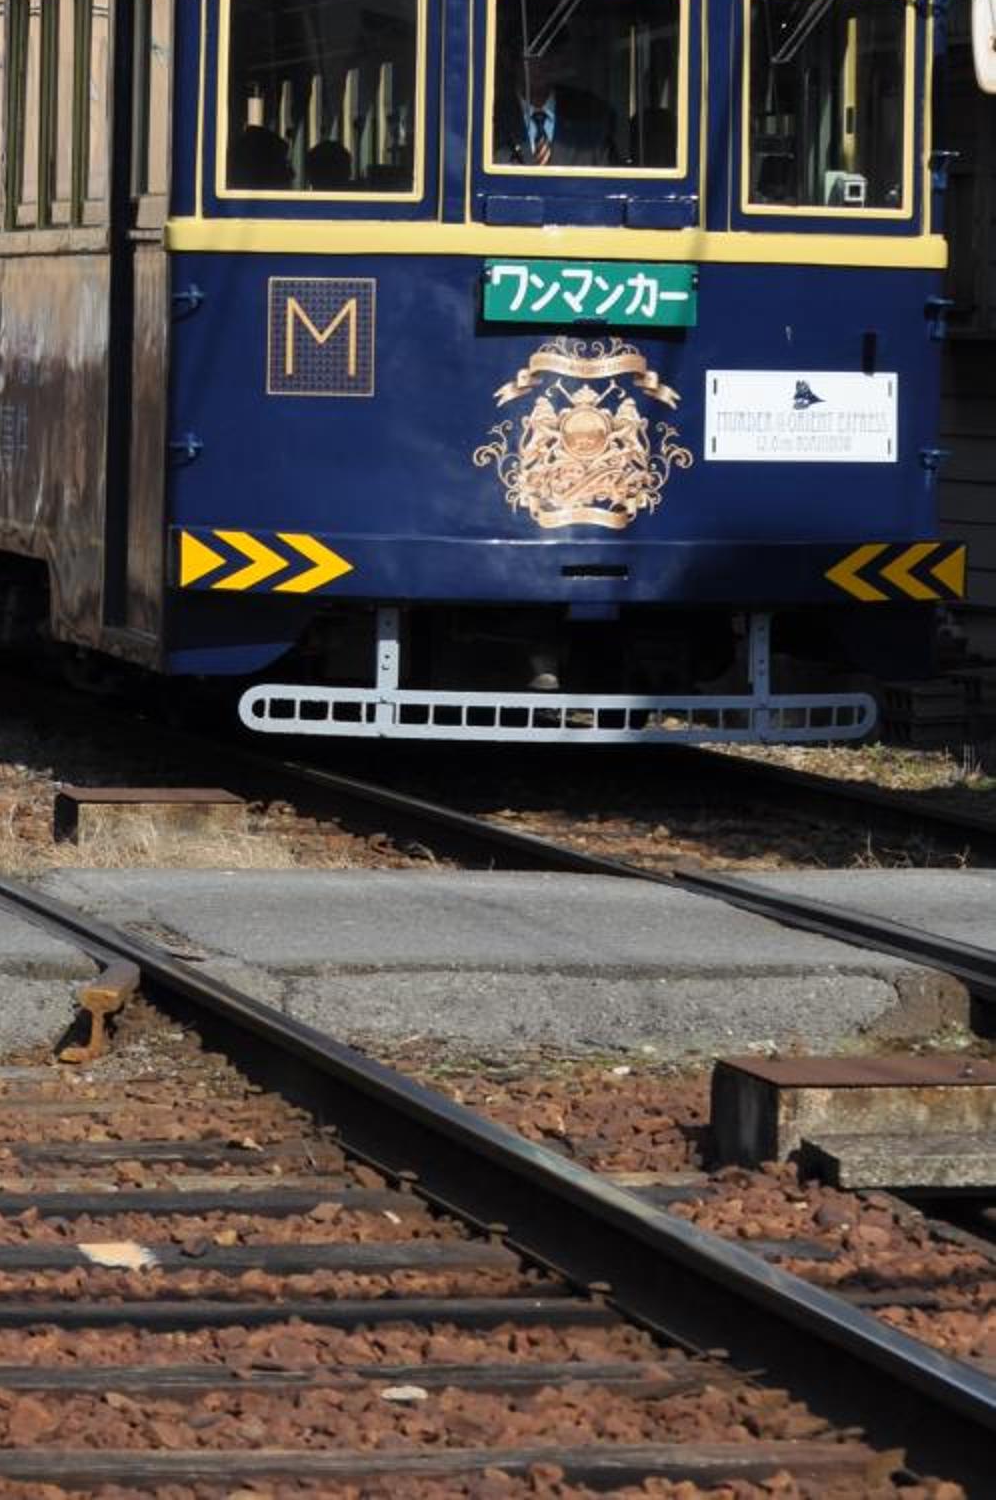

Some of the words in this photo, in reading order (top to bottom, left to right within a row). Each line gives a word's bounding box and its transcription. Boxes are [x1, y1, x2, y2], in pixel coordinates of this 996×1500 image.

[491, 265, 689, 318] ワンマンカー
[286, 297, 356, 376] M
